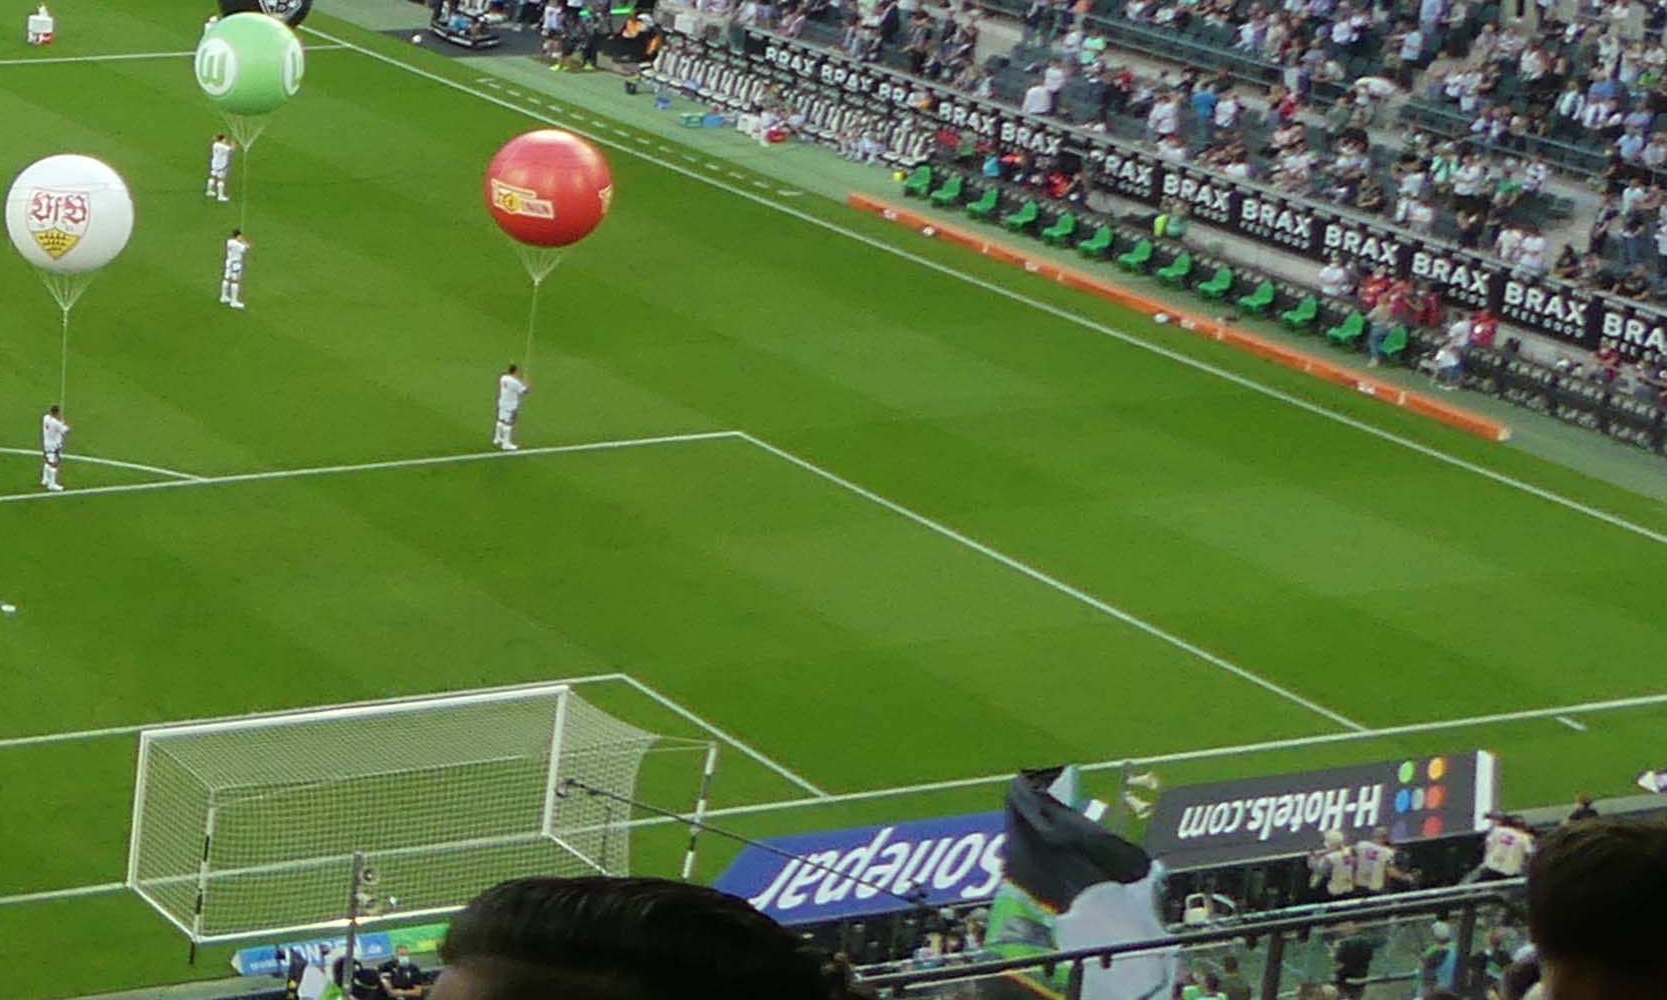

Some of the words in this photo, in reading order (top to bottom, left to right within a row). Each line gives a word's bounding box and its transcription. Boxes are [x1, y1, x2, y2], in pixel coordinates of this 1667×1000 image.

[821, 65, 874, 92] BRAX
[879, 82, 919, 107] BRA
[939, 103, 997, 137] BRAX
[1002, 122, 1062, 156] BRAX
[30, 191, 87, 225] VfB
[1163, 174, 1231, 212] BRAX
[1242, 199, 1313, 239] BRAX
[1324, 224, 1401, 266] BRAX
[1412, 252, 1491, 297] BRAX
[1504, 281, 1588, 327] BRAX
[1178, 783, 1384, 841] H-Hotels.com
[748, 826, 1008, 911] Sonepar
